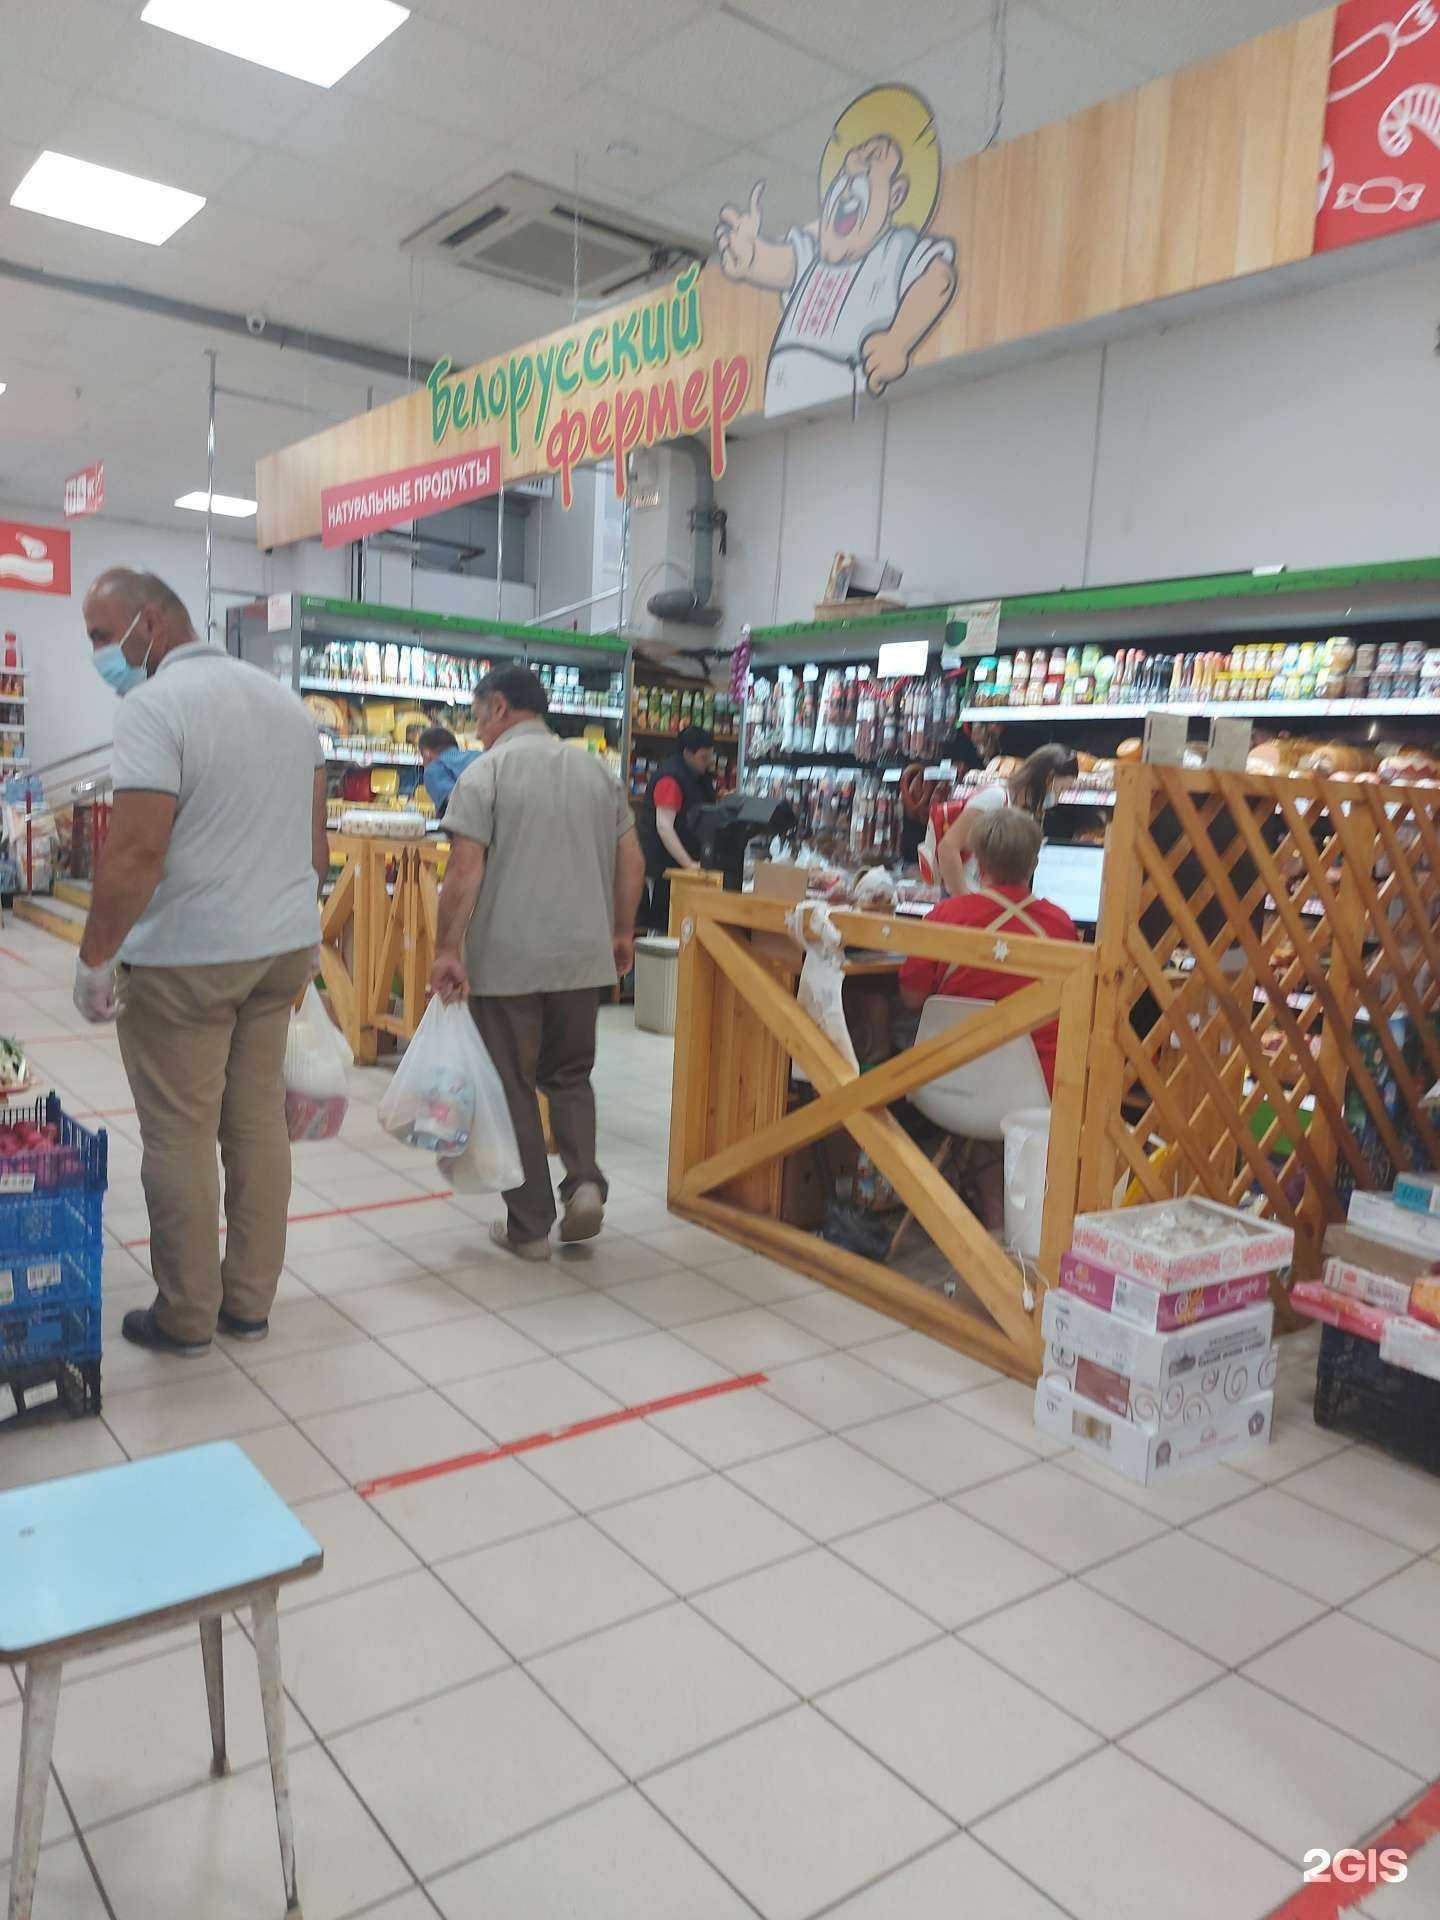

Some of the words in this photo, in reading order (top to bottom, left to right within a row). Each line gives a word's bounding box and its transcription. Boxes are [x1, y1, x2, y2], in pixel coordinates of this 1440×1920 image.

[427, 261, 703, 457] Белорусский
[546, 355, 750, 511] фермер
[327, 479, 411, 529] НАТУРАЛЬНЫЕ
[414, 455, 491, 502] ПРОДУКТЫ
